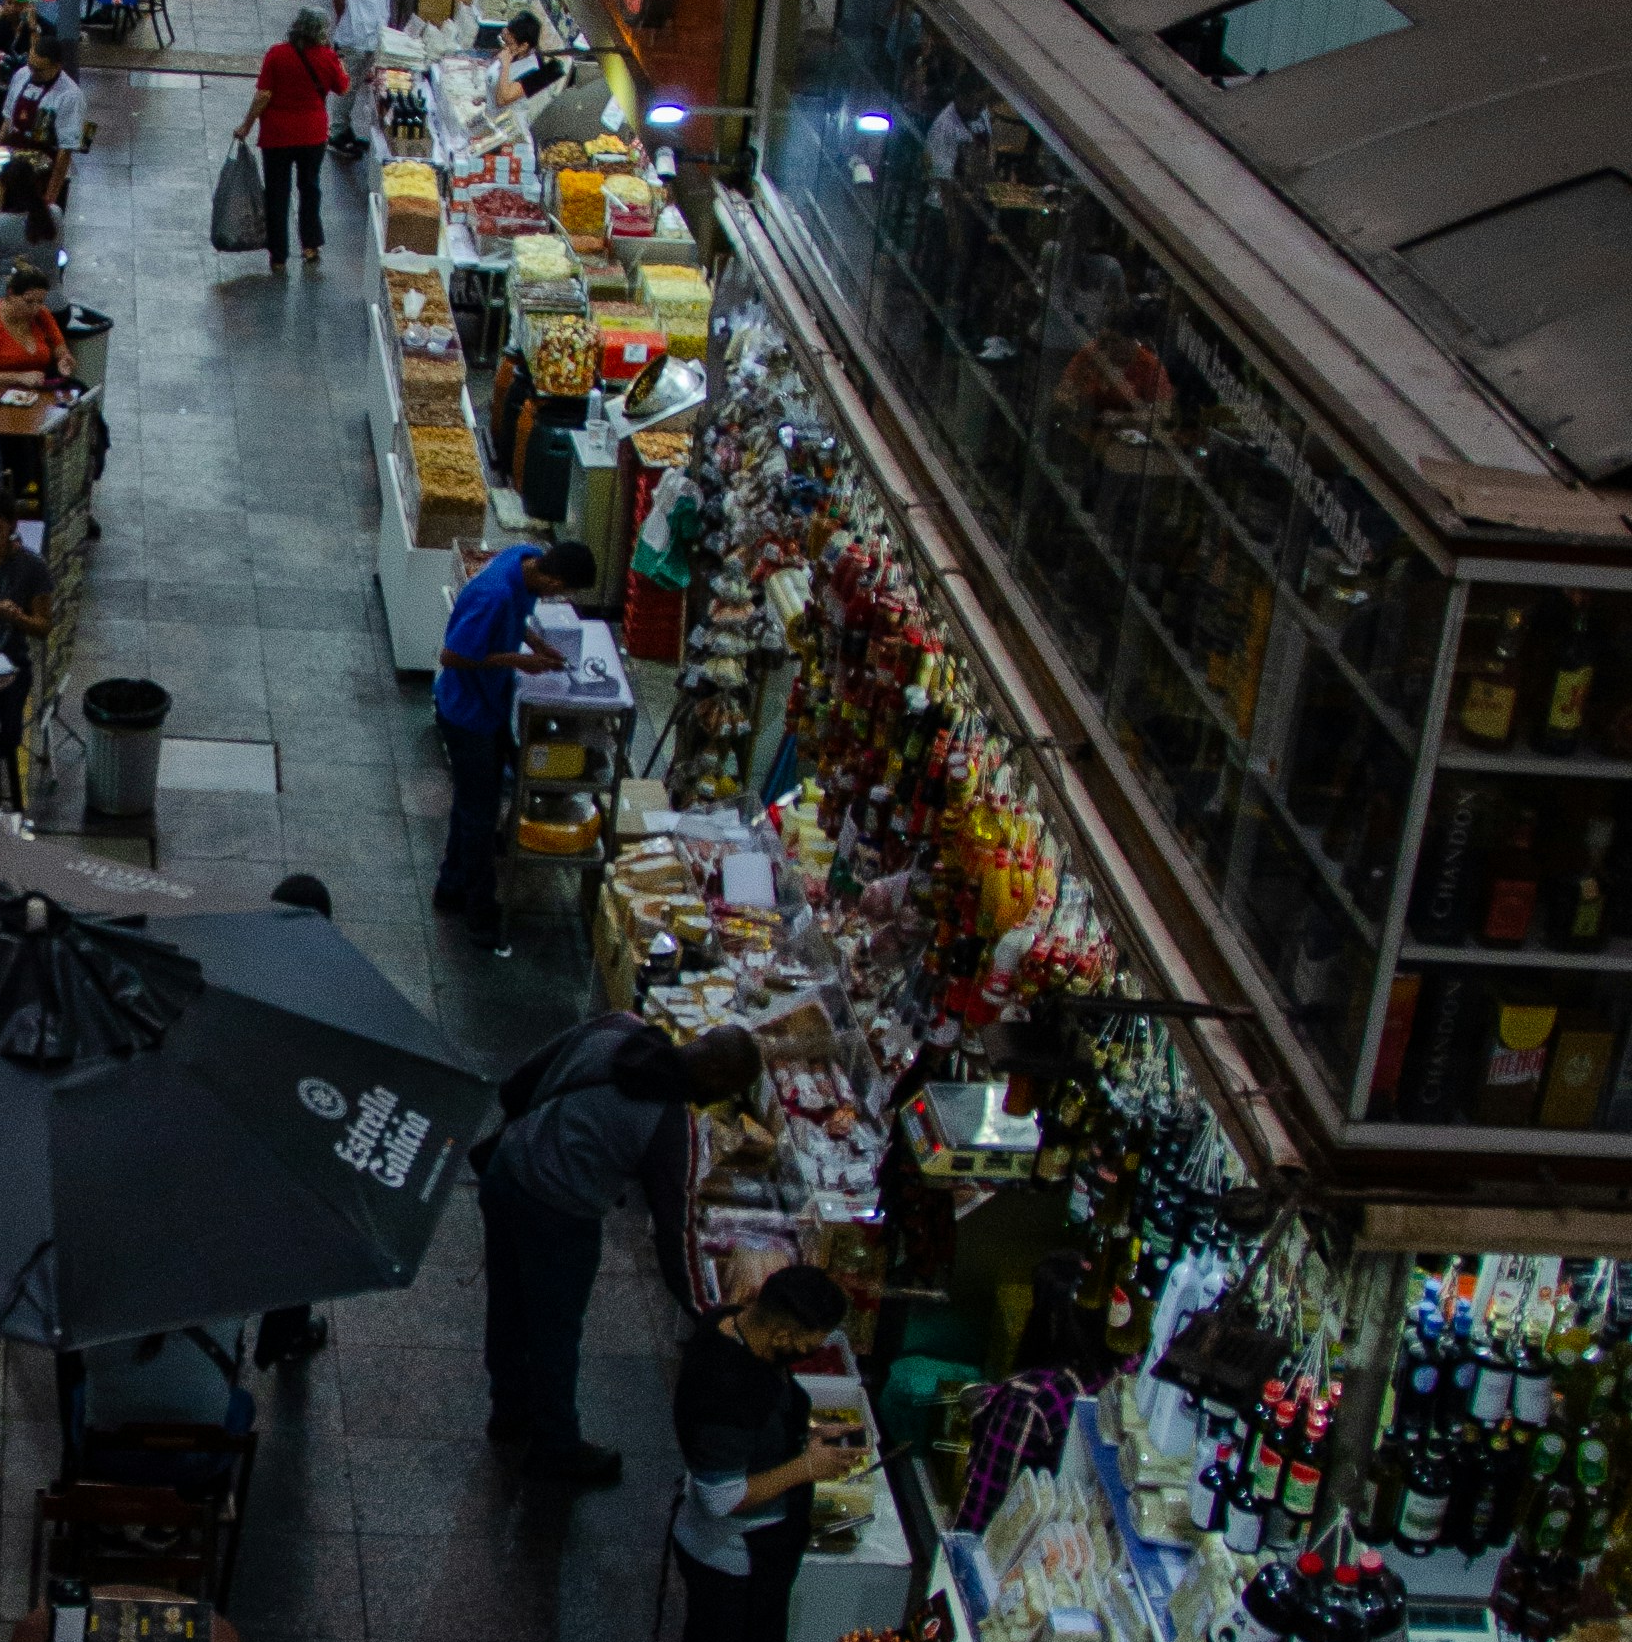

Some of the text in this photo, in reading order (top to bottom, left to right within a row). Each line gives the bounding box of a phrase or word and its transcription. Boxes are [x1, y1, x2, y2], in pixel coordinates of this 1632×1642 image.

[1428, 789, 1477, 920] CHANDON
[334, 1084, 399, 1173] Estrella
[368, 1109, 431, 1188] Galicia
